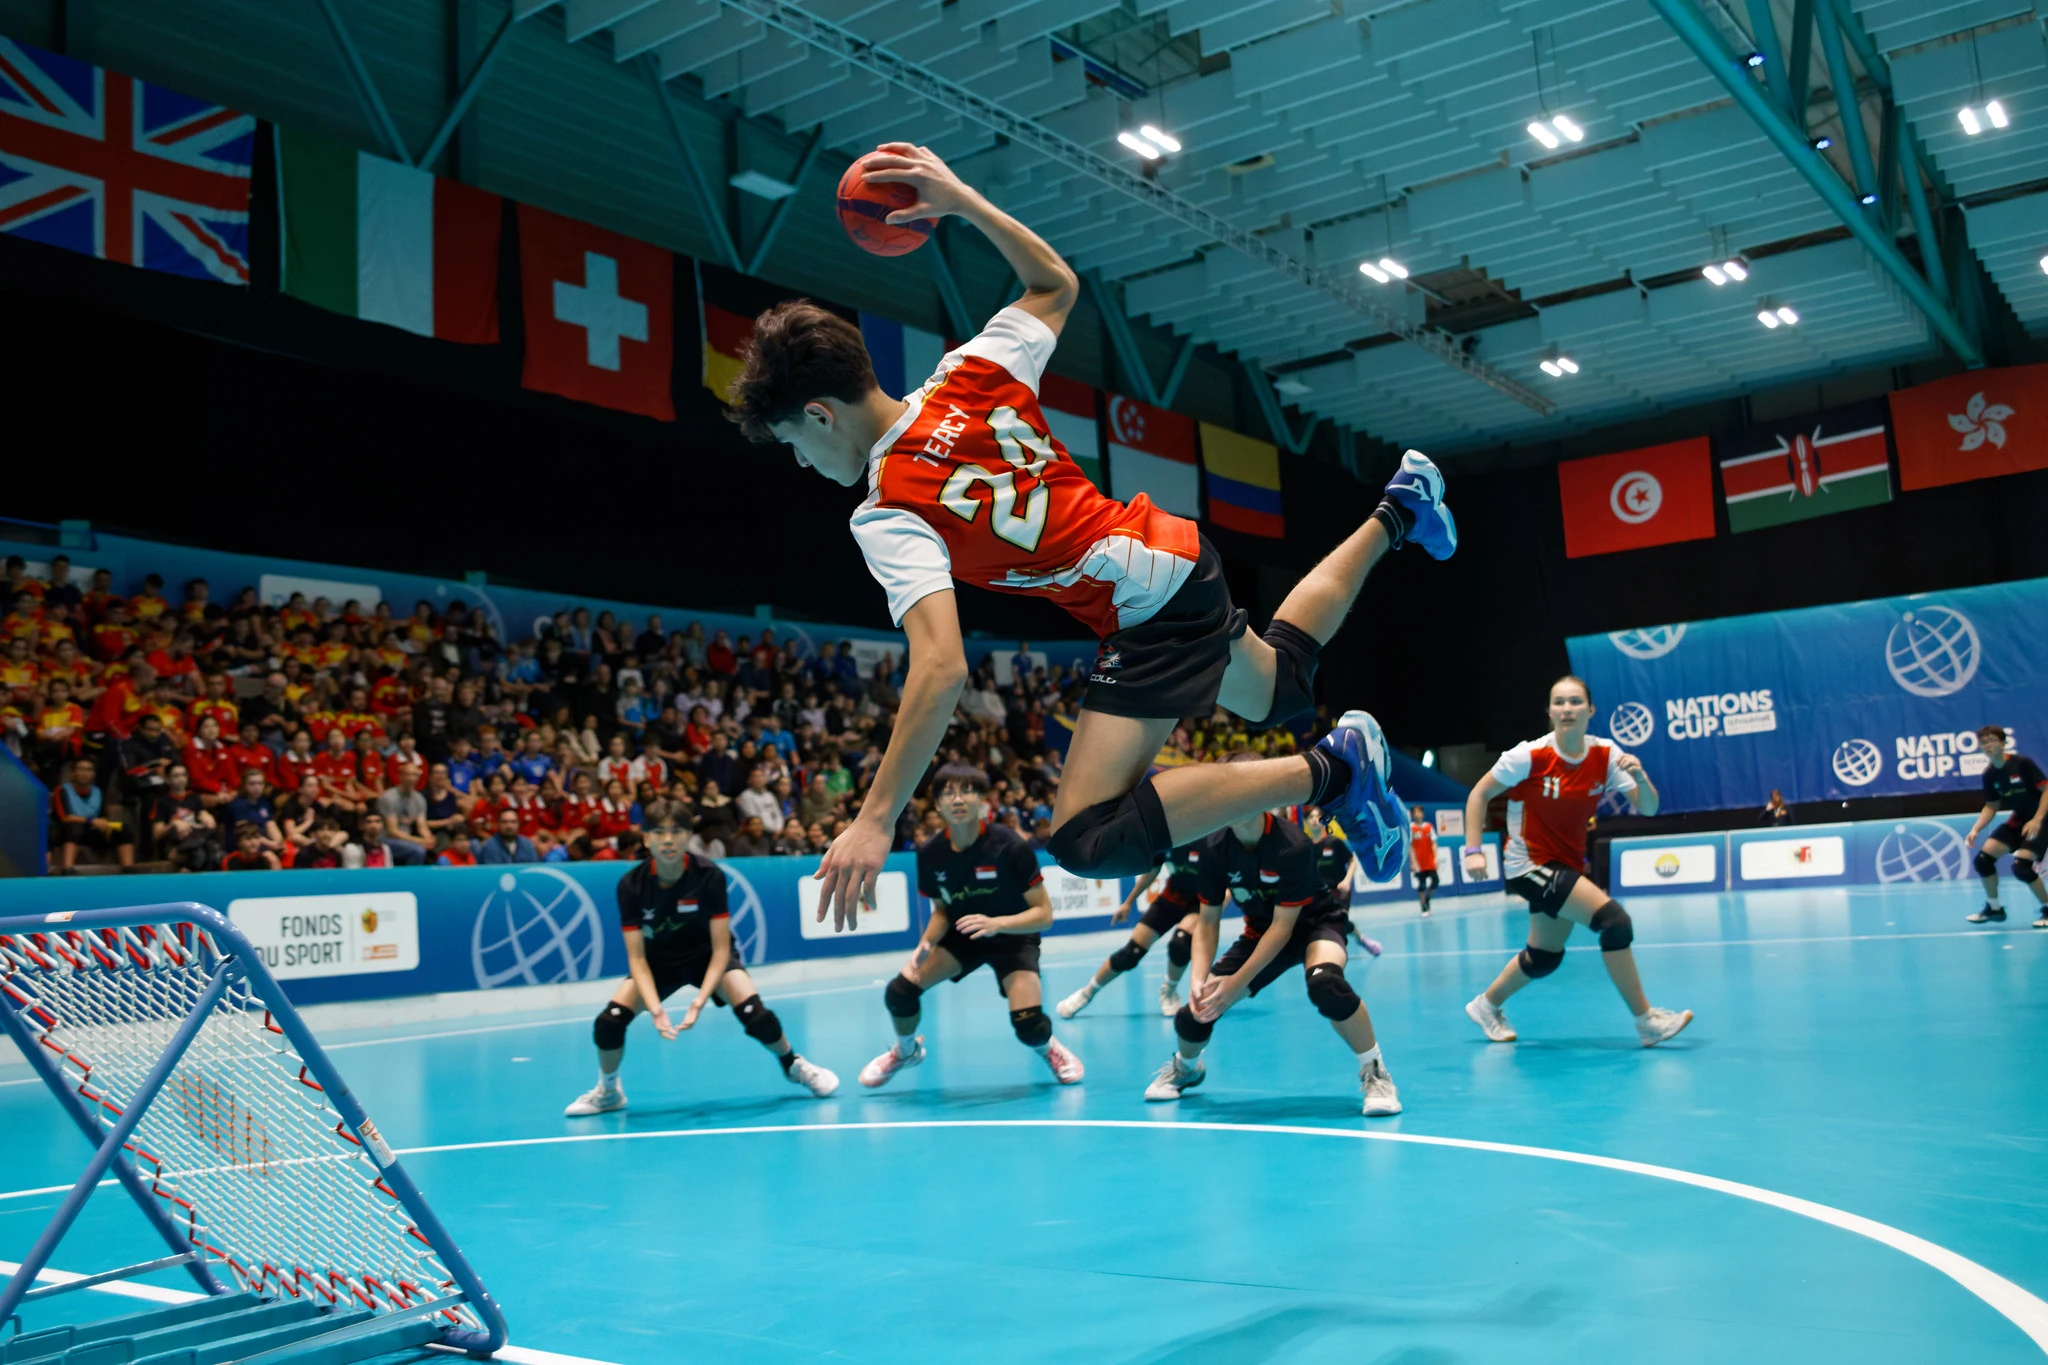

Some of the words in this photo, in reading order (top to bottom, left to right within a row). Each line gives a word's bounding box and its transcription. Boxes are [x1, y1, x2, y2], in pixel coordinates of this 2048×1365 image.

[912, 403, 970, 468] TERCY
[937, 405, 1060, 554] 24
[1666, 689, 1774, 721] NATIONS
[1896, 727, 2018, 760] NATIOS
[1543, 776, 1561, 799] 11
[281, 914, 342, 938] FONDS
[285, 941, 344, 966] SPORT
